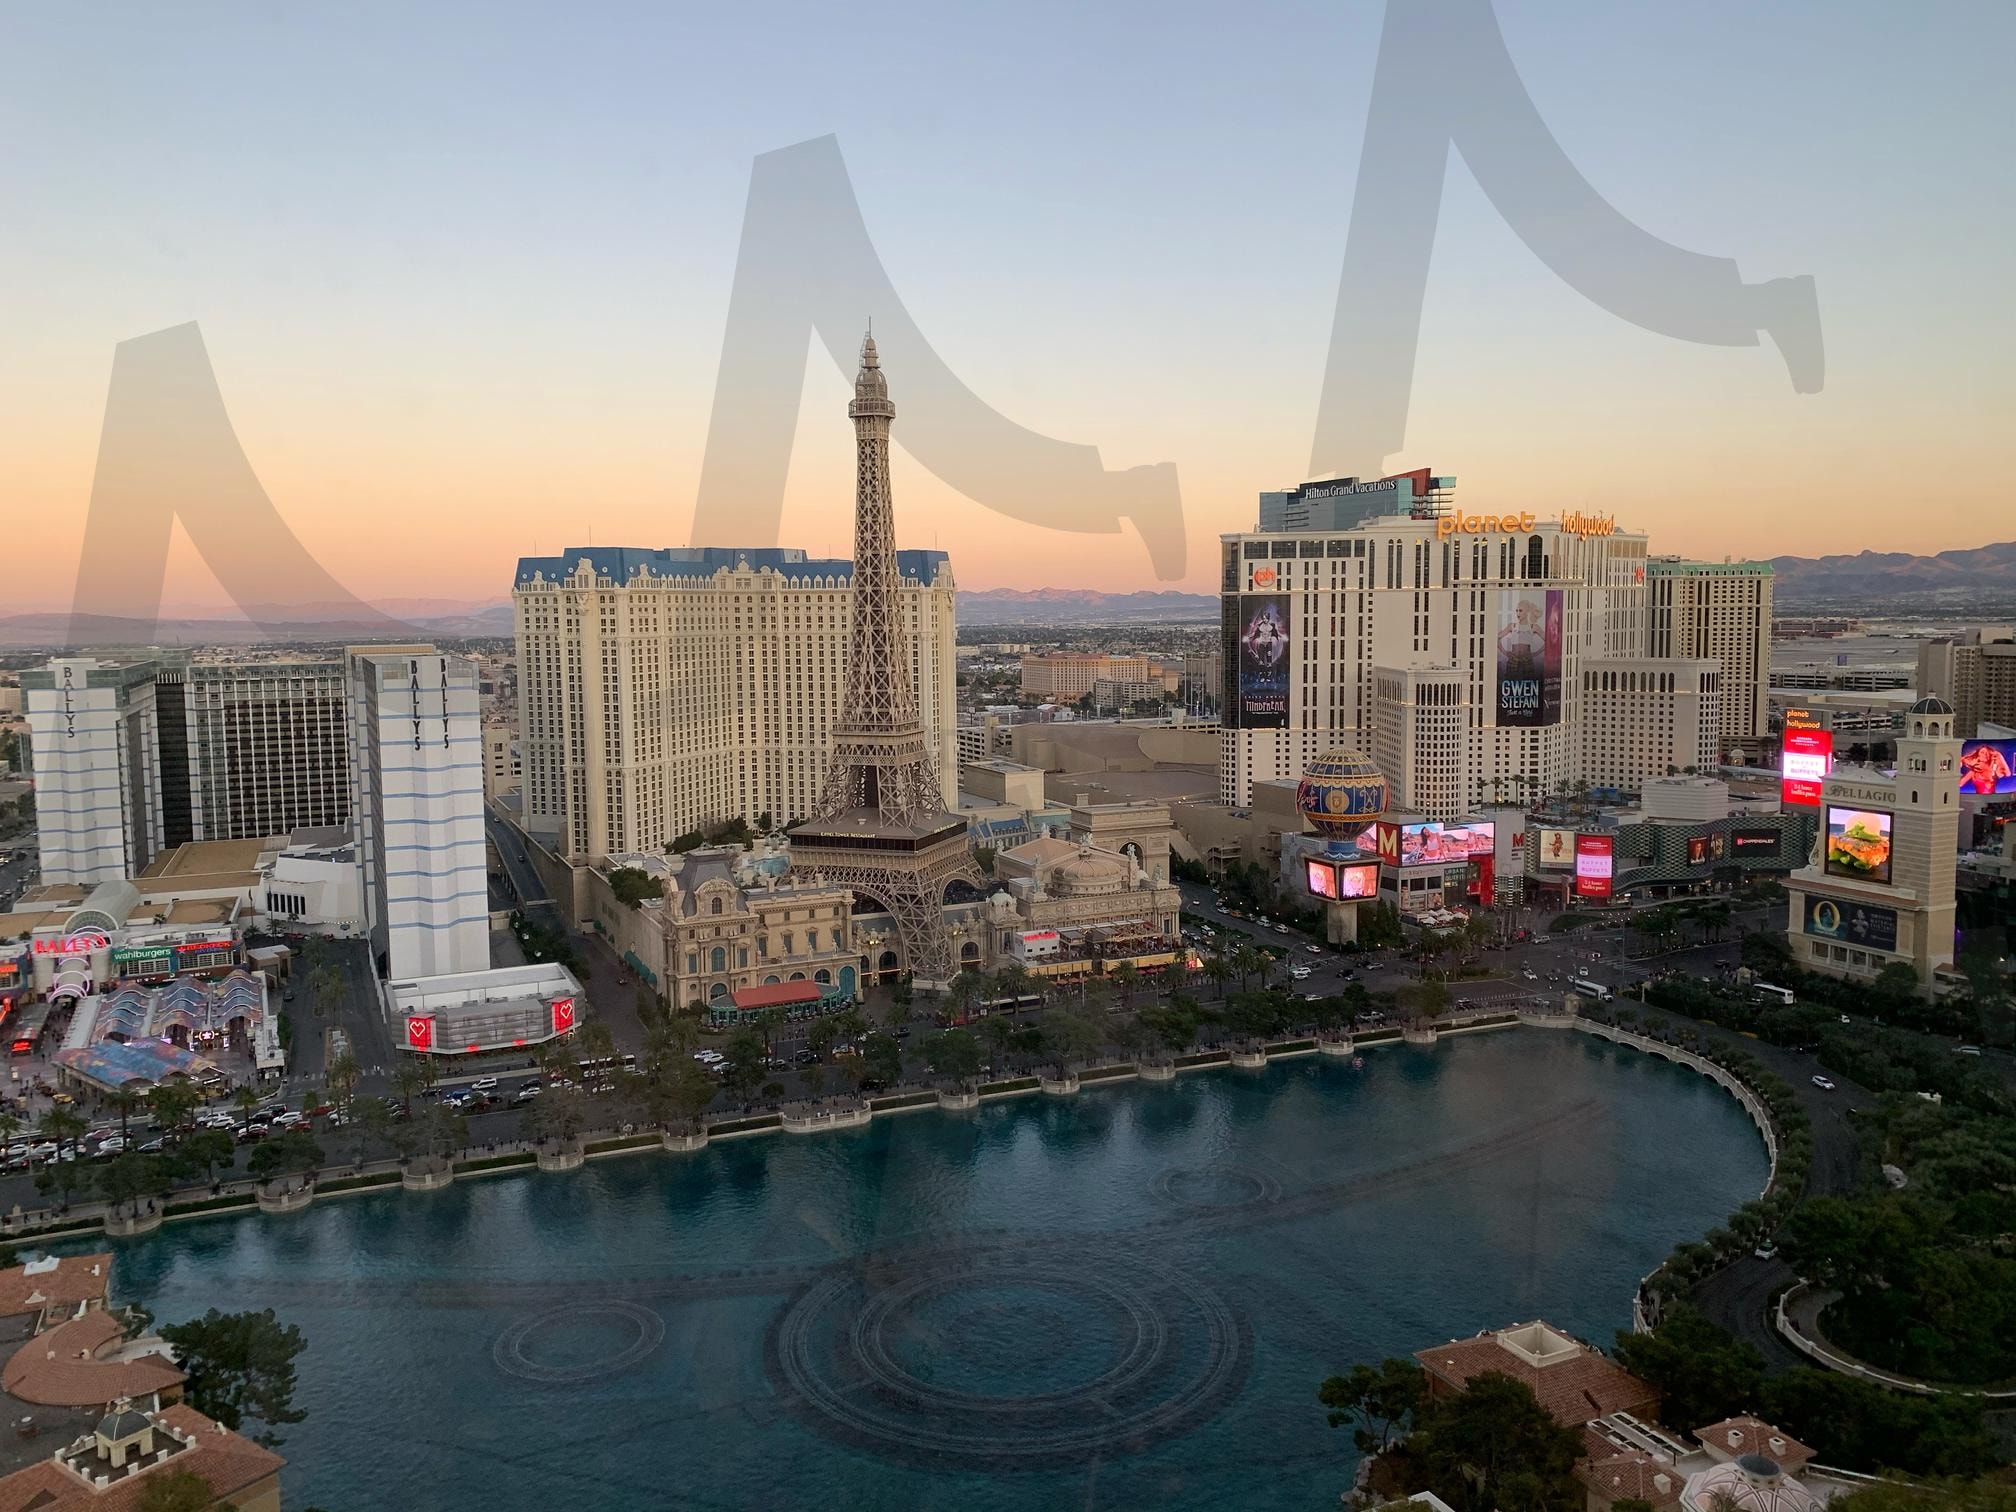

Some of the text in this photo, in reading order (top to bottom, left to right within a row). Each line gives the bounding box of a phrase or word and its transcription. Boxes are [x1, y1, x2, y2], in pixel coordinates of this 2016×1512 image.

[1305, 480, 1396, 500] Hilton Grand Vacations
[1437, 509, 1615, 541] planet hollywood
[1501, 680, 1539, 697] GWEN
[63, 667, 75, 738] BALLYS
[411, 660, 421, 751] BALLYS
[440, 658, 449, 749] BALLYS
[1501, 696, 1539, 709] STEFANI
[1787, 710, 1810, 718] planet
[1787, 719, 1821, 729] hollywood
[1825, 785, 1897, 803] BELLAGIO
[1380, 827, 1397, 857] M
[1513, 833, 1524, 848] M
[114, 948, 172, 960] wahlburgers
